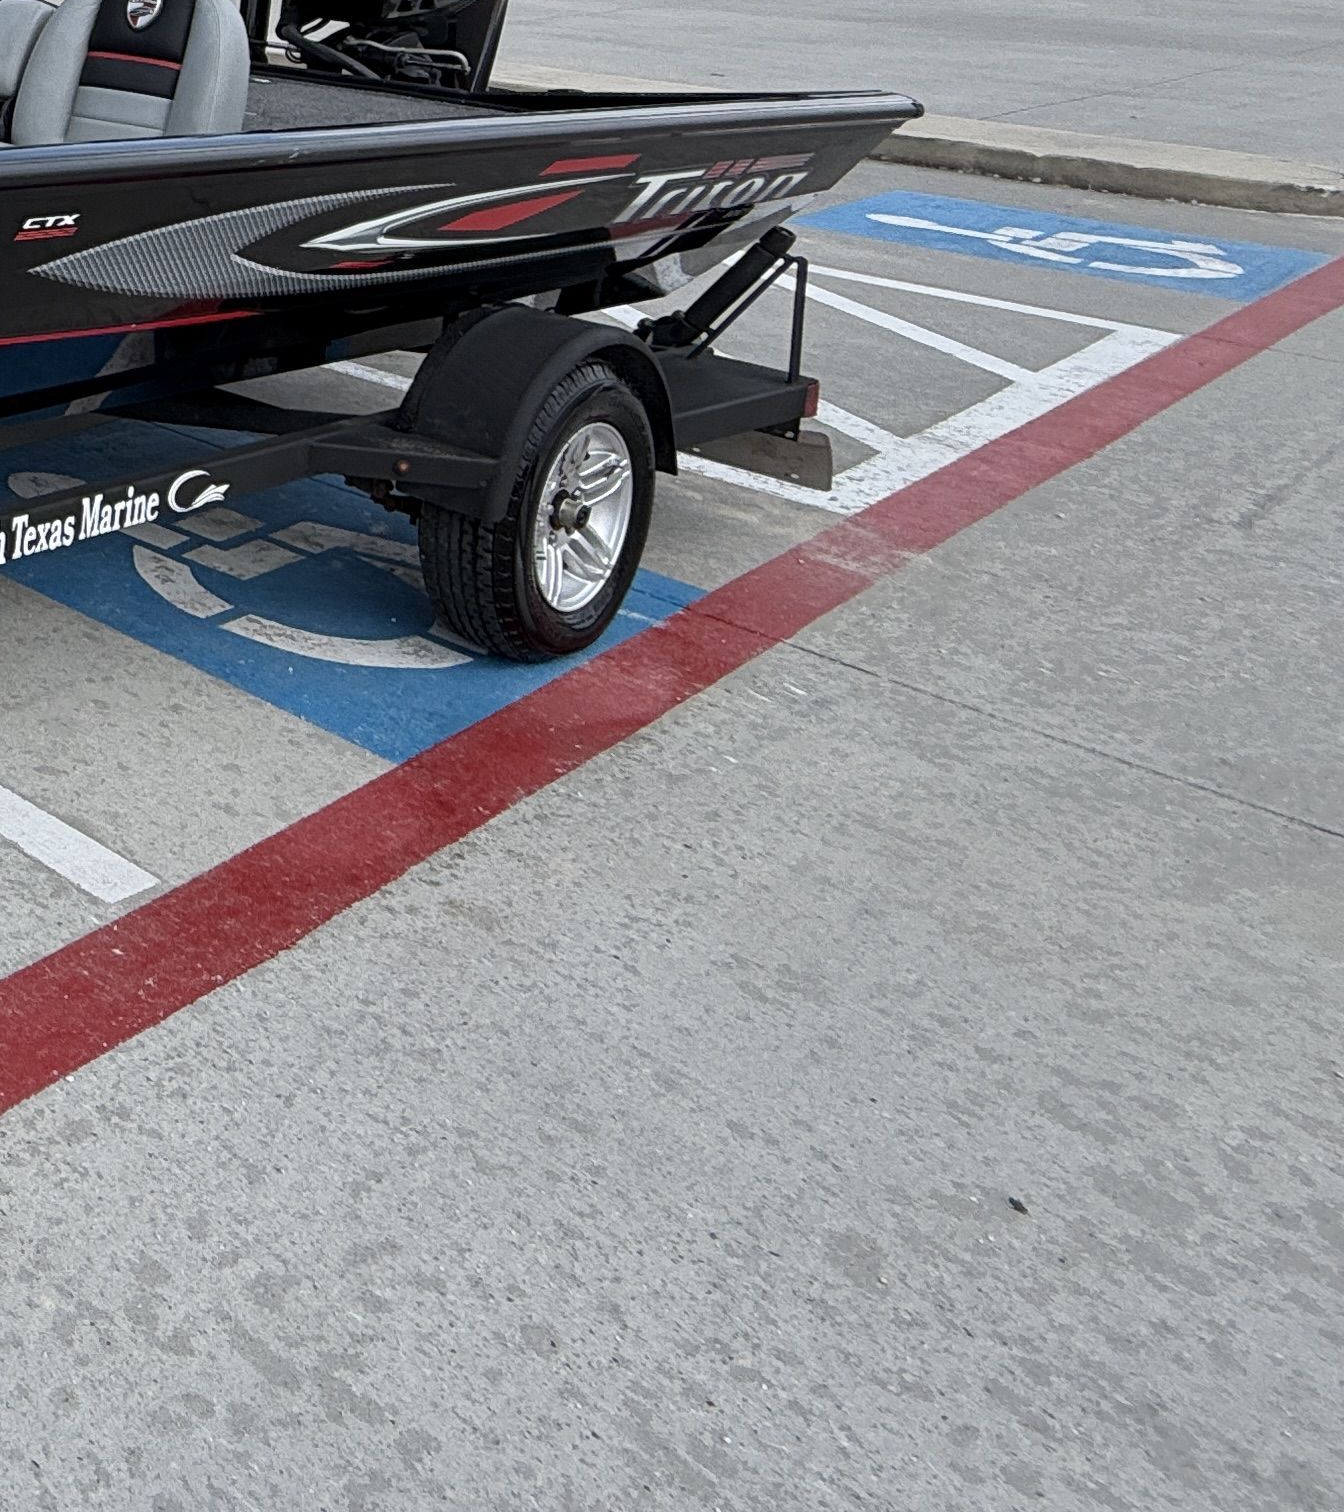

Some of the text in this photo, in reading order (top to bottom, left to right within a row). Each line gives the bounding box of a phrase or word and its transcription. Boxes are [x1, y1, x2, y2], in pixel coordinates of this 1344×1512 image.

[21, 213, 81, 230] CTX
[613, 161, 810, 224] Triton
[11, 513, 75, 561] Texas
[78, 485, 160, 541] Marine
